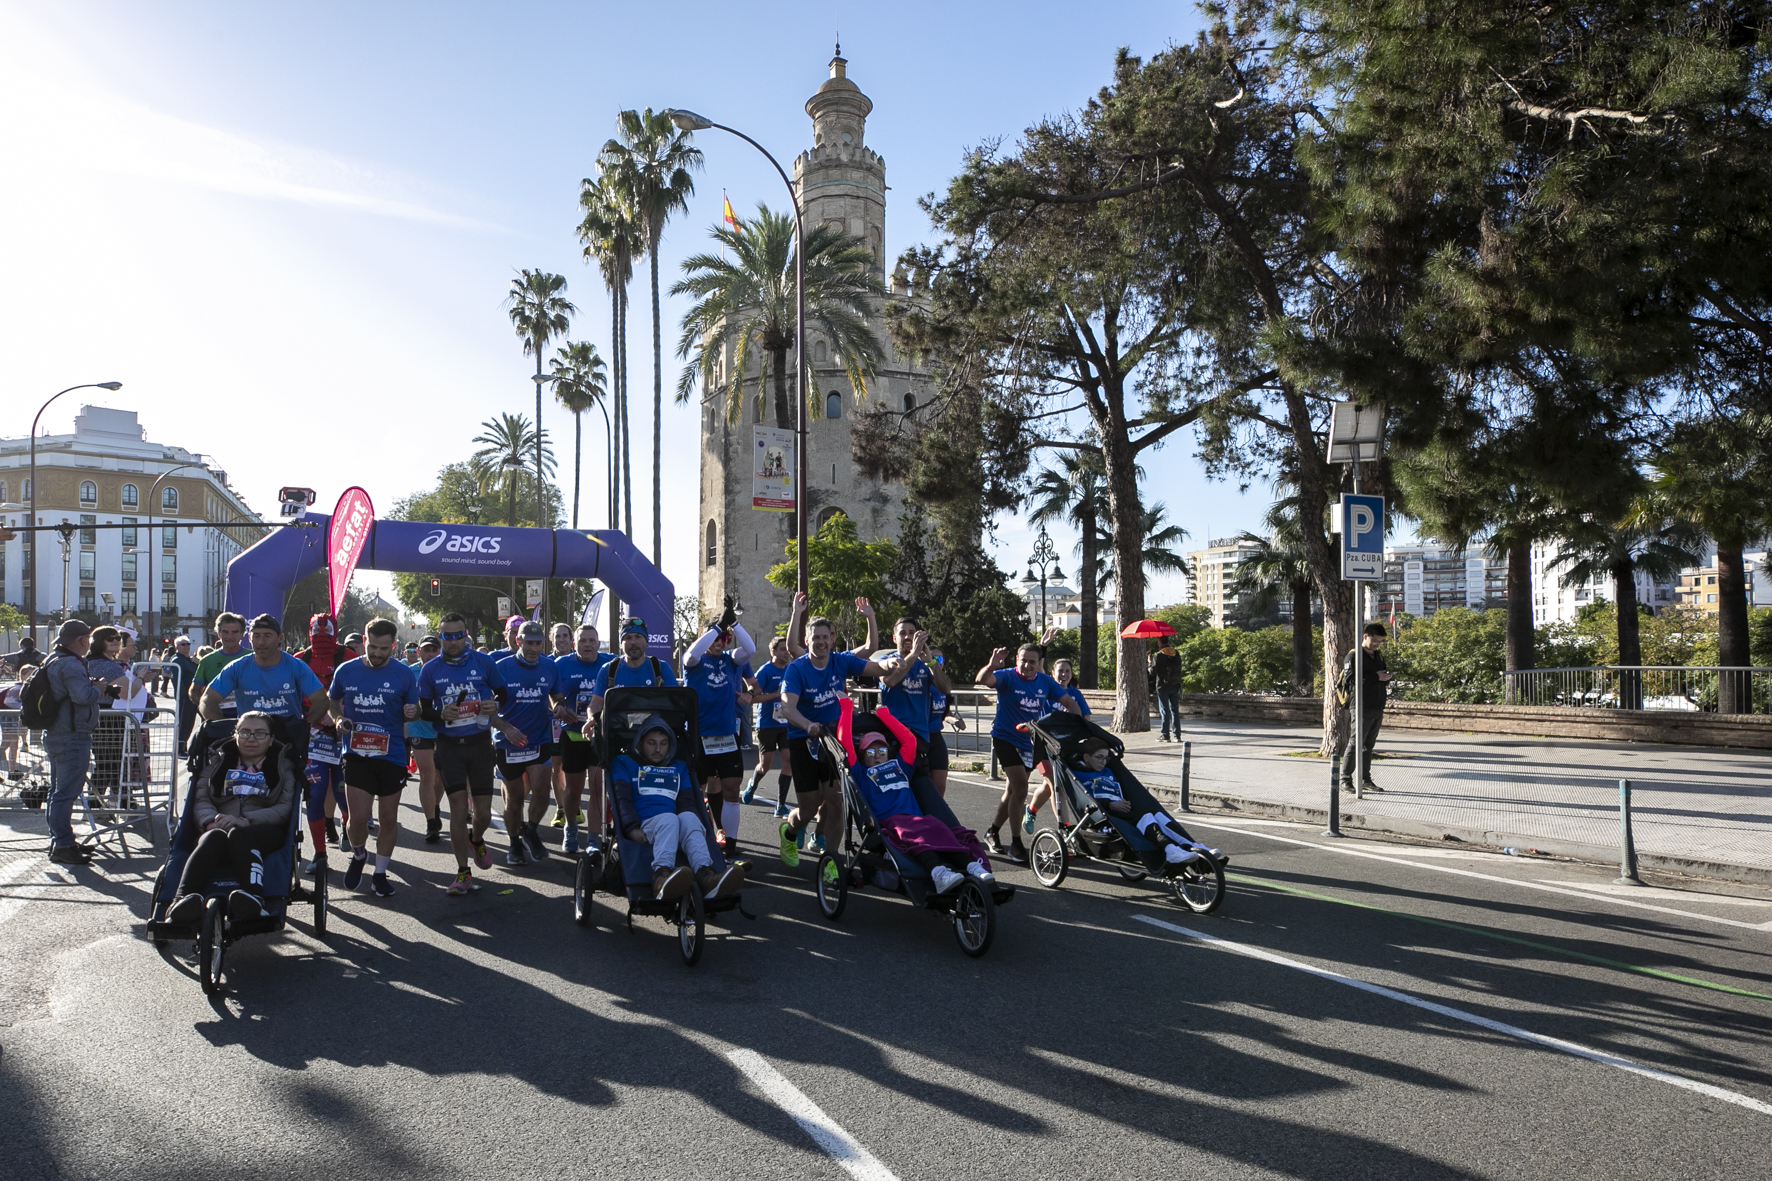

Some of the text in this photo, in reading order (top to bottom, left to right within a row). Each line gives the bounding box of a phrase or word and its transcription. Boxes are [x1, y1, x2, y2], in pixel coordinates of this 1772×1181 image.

[337, 500, 366, 566] aefat
[1351, 504, 1374, 548] P
[1346, 554, 1381, 562] Pza. CUBA
